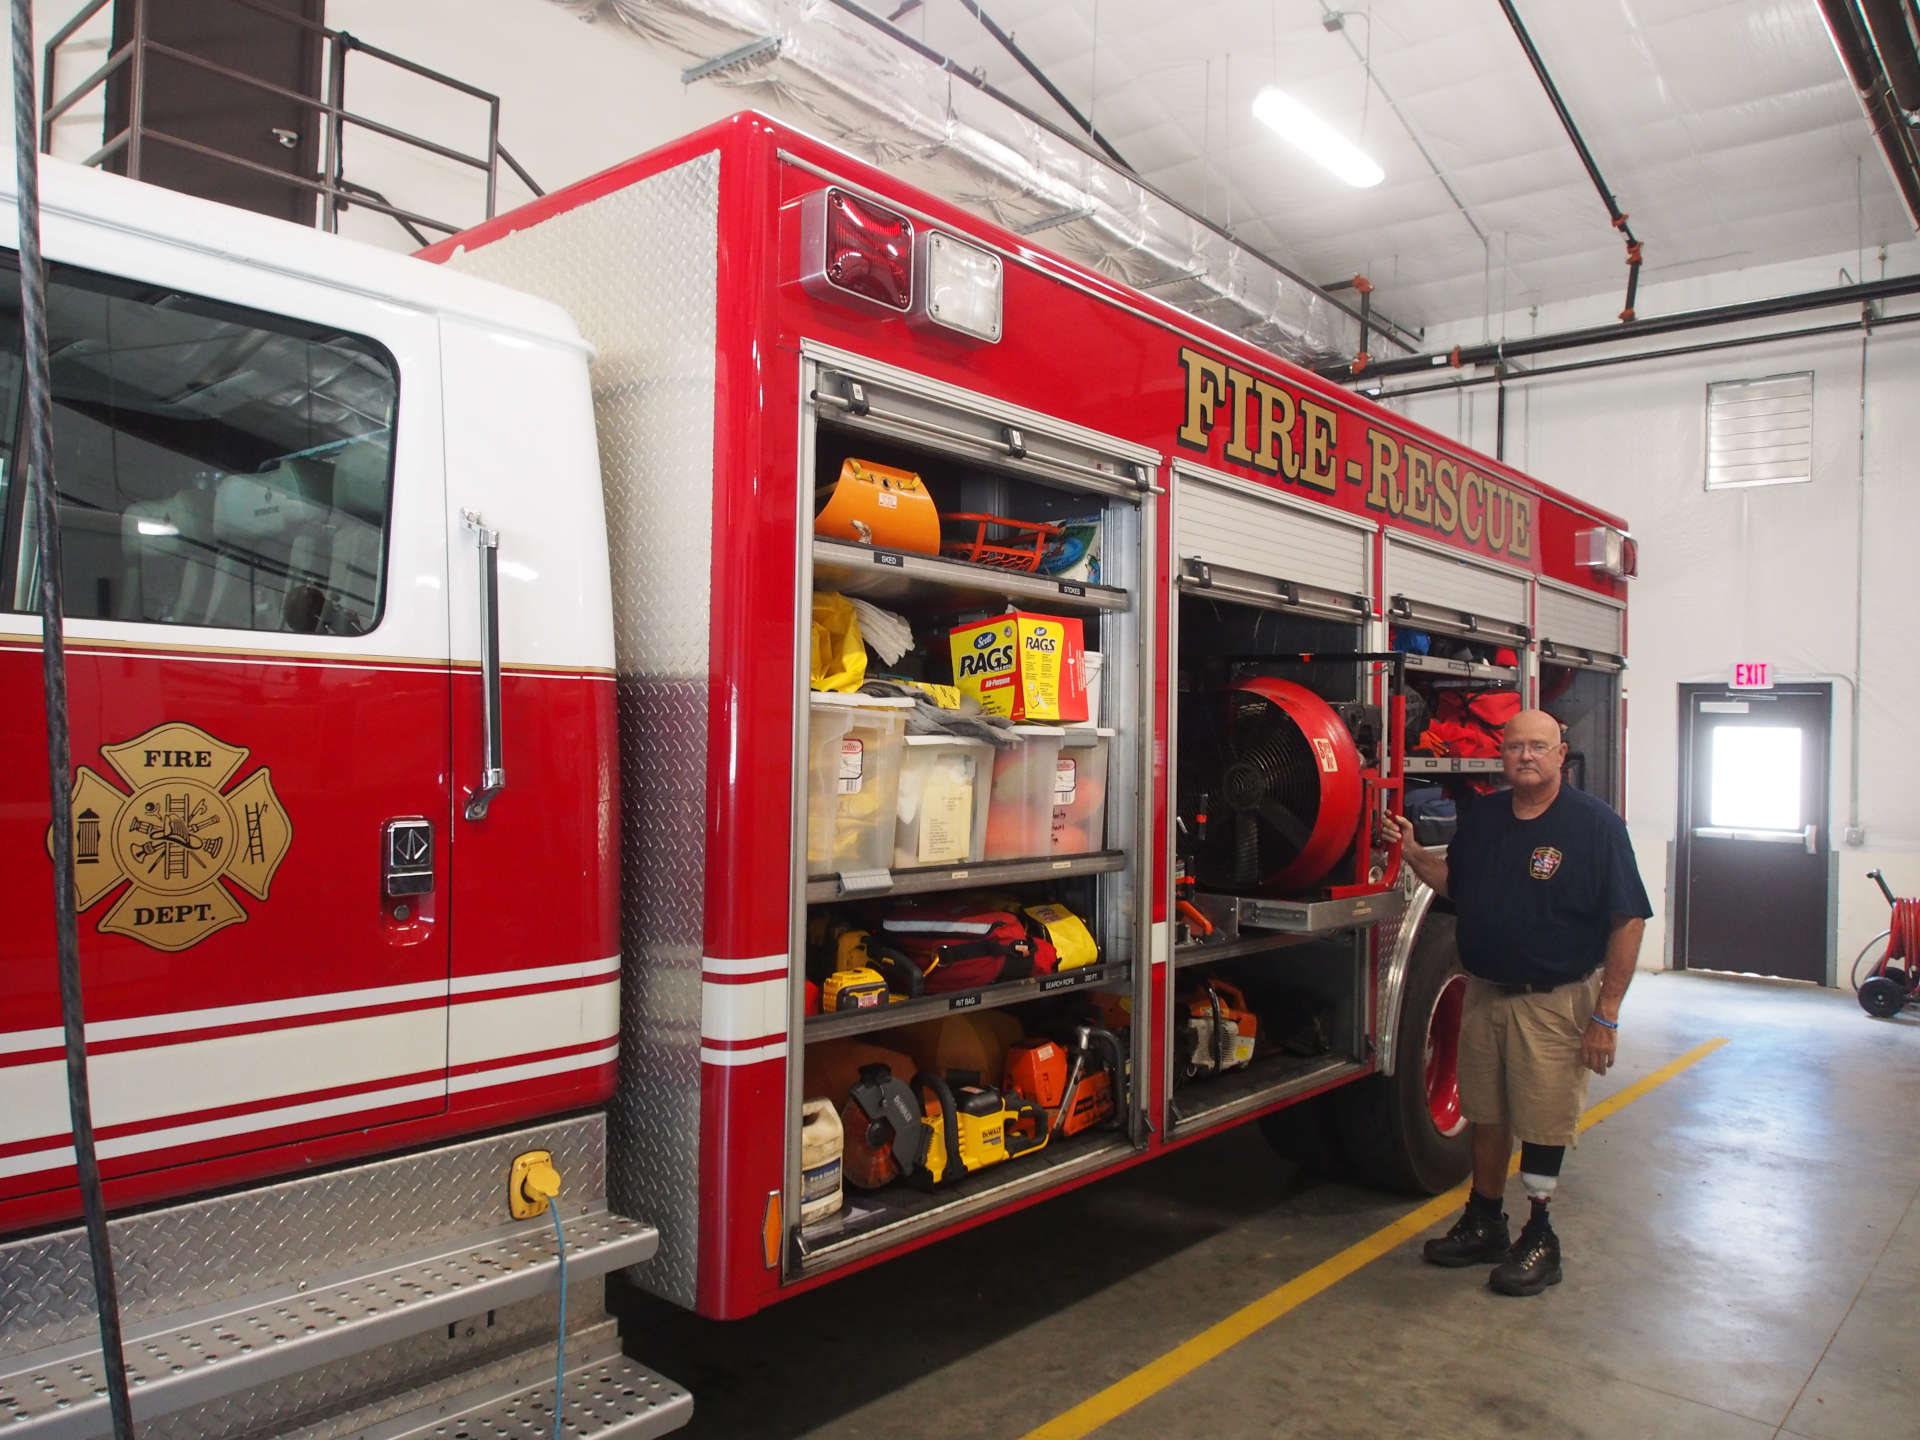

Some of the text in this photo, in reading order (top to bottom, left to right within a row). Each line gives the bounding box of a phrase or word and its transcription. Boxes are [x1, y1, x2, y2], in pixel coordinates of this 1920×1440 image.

[977, 632, 994, 649] Scott
[1026, 636, 1056, 651] RAGS
[959, 644, 1013, 678] RAGS
[1736, 663, 1767, 685] EXIT
[143, 750, 212, 768] FIRE
[133, 903, 216, 926] DEPT.
